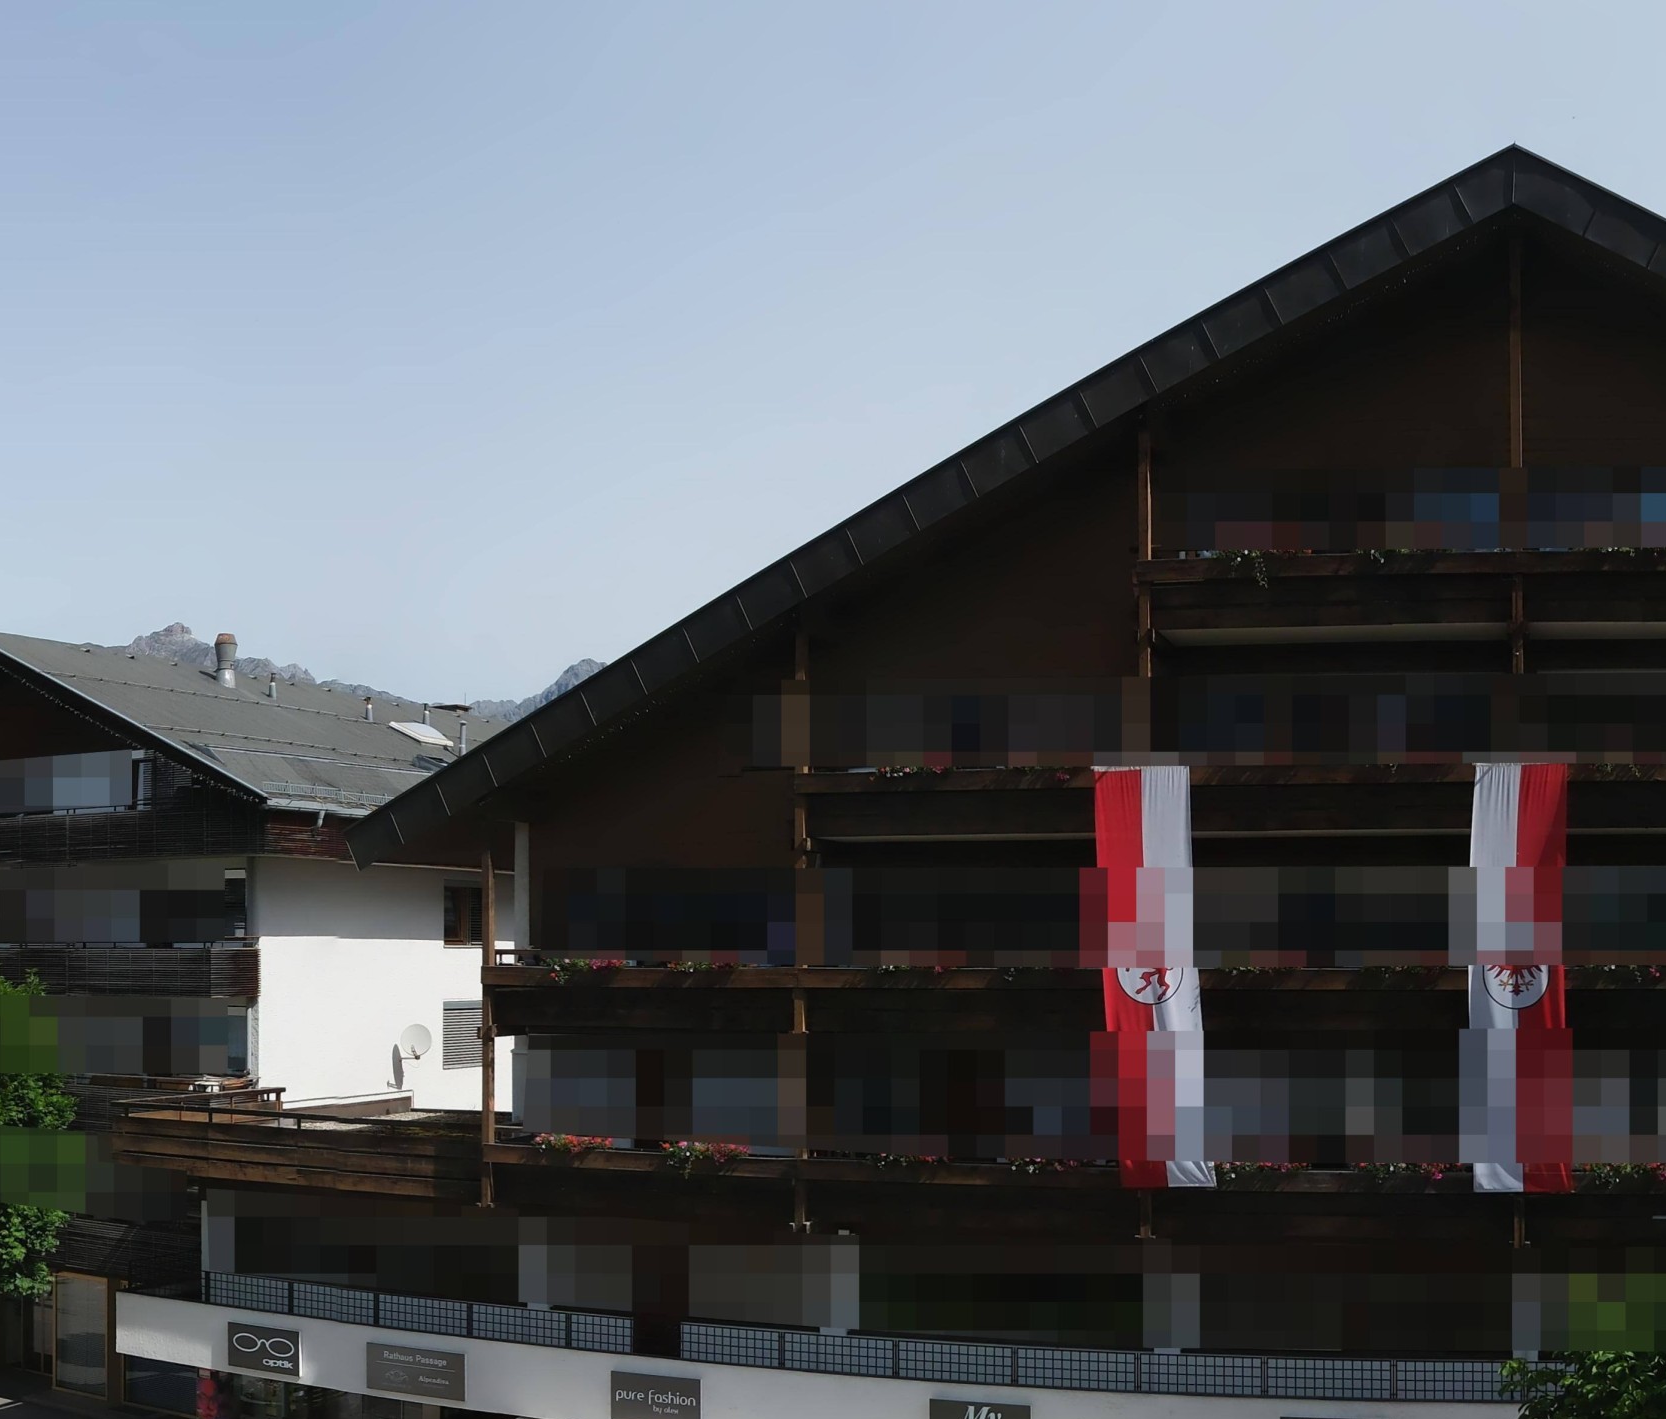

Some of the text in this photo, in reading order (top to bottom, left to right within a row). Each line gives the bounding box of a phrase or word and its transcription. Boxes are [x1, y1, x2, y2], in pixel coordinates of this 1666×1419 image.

[262, 1358, 294, 1369] optik
[383, 1350, 448, 1367] Rathaus Passage
[615, 1389, 696, 1407] pure fashion
[652, 1404, 663, 1414] by
